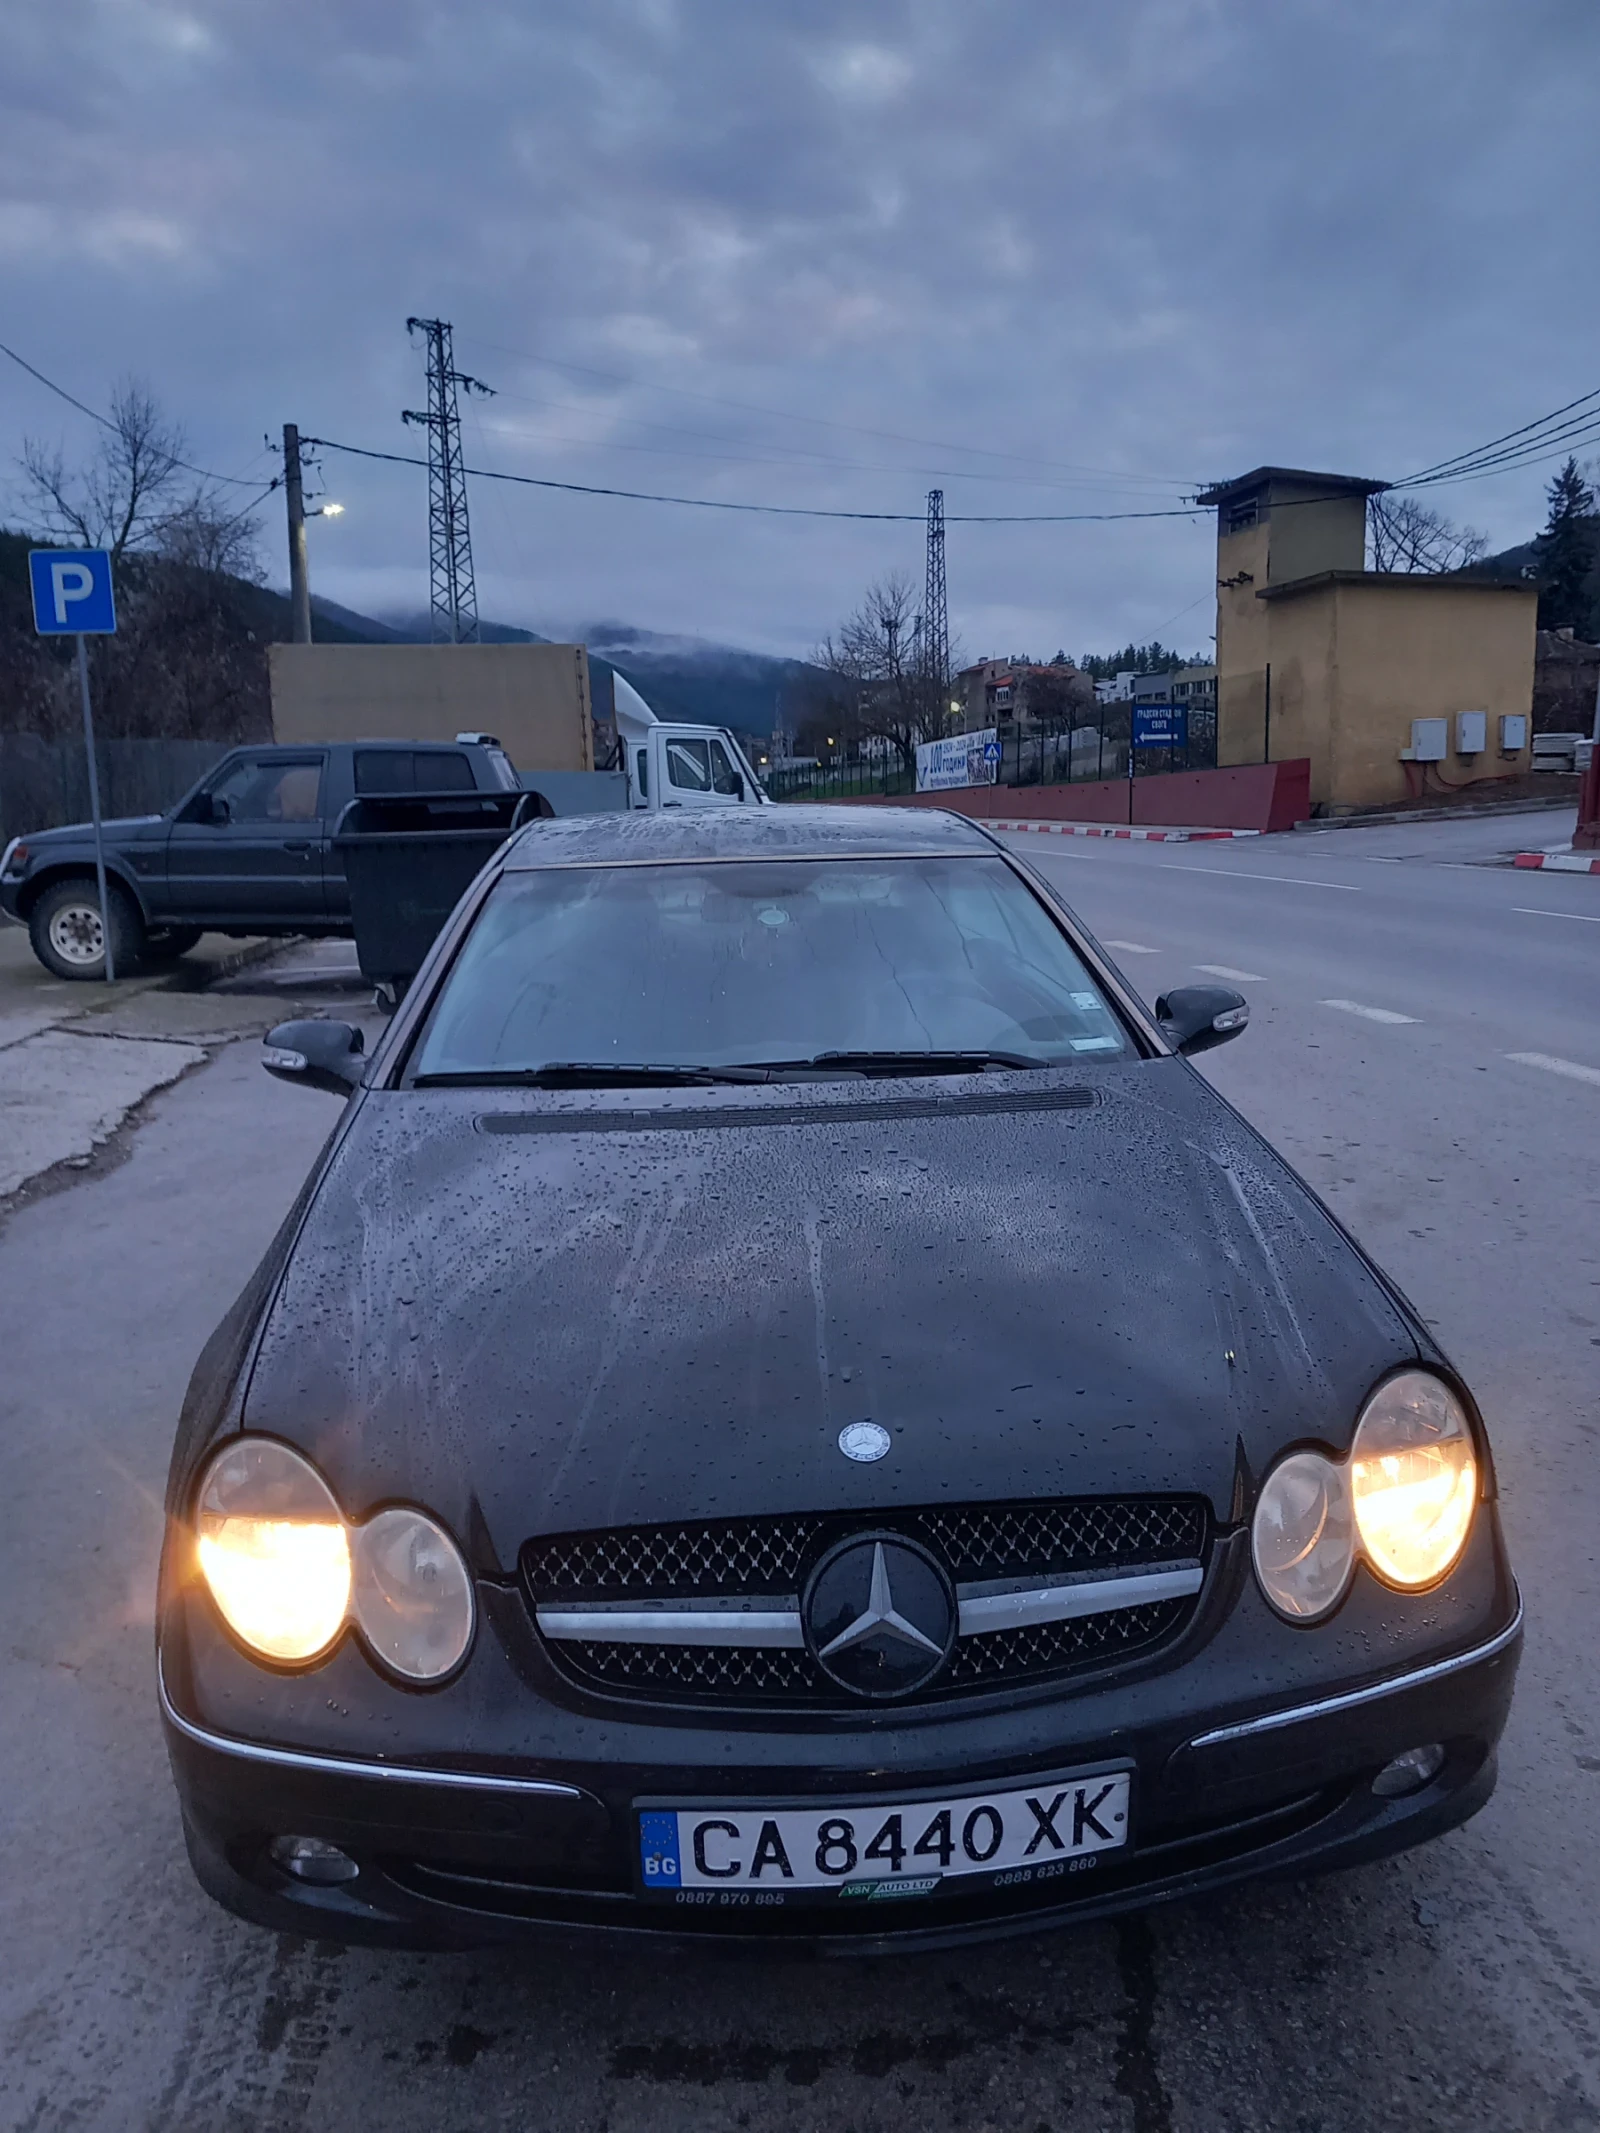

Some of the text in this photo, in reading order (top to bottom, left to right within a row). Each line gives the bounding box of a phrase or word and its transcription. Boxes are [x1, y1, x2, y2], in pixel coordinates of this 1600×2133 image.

[51, 562, 94, 624] P
[930, 743, 943, 774] 100
[693, 1784, 1117, 1878] CA 8440 XK
[644, 1857, 677, 1876] BG
[1036, 1863, 1065, 1879] 623
[1069, 1856, 1097, 1872] 860
[847, 1885, 871, 1895] VSN
[877, 1882, 910, 1892] AUTO
[912, 1880, 934, 1889] LTD
